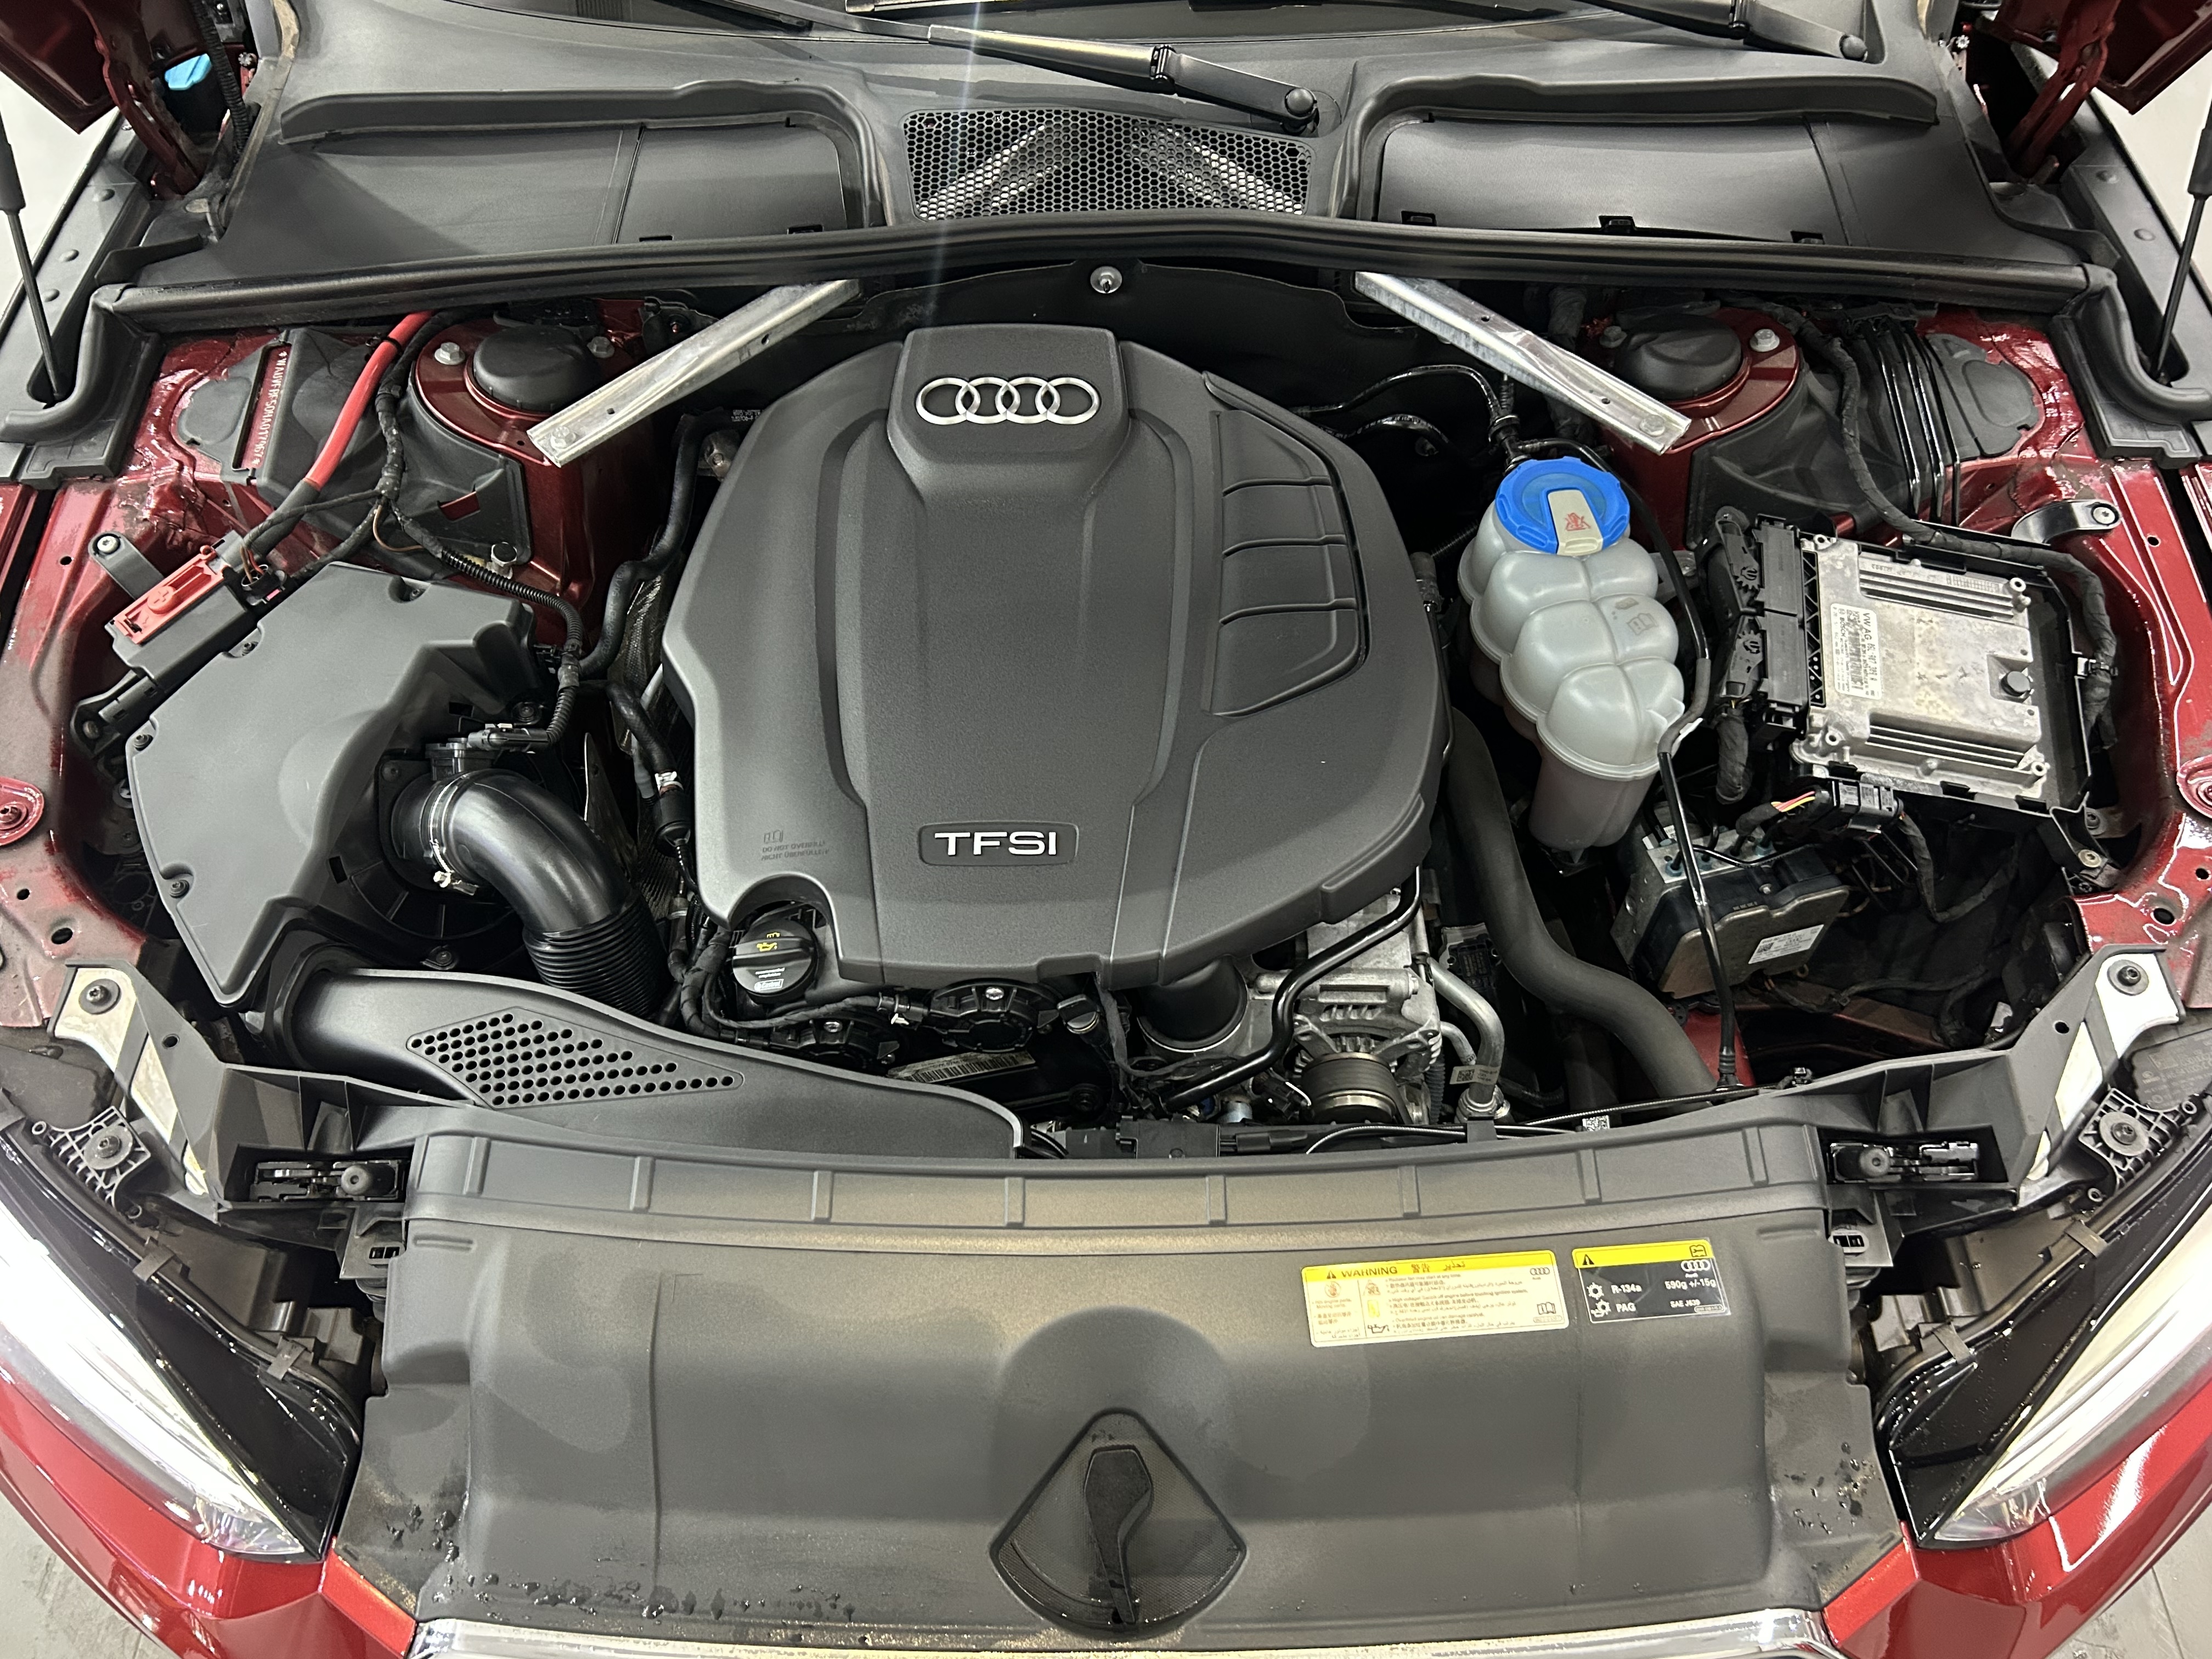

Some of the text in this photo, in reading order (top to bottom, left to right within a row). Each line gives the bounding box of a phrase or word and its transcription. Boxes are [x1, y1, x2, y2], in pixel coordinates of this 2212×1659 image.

[1863, 613, 1871, 627] VW
[1864, 627, 1872, 640] AG
[934, 831, 1058, 856] TFSI
[1341, 1266, 1398, 1278] WARNING
[1611, 1283, 1643, 1294] R-134a
[1664, 1278, 1717, 1290] 590g +/-15g
[1616, 1302, 1637, 1313] PAG
[1670, 1300, 1684, 1308] SAE
